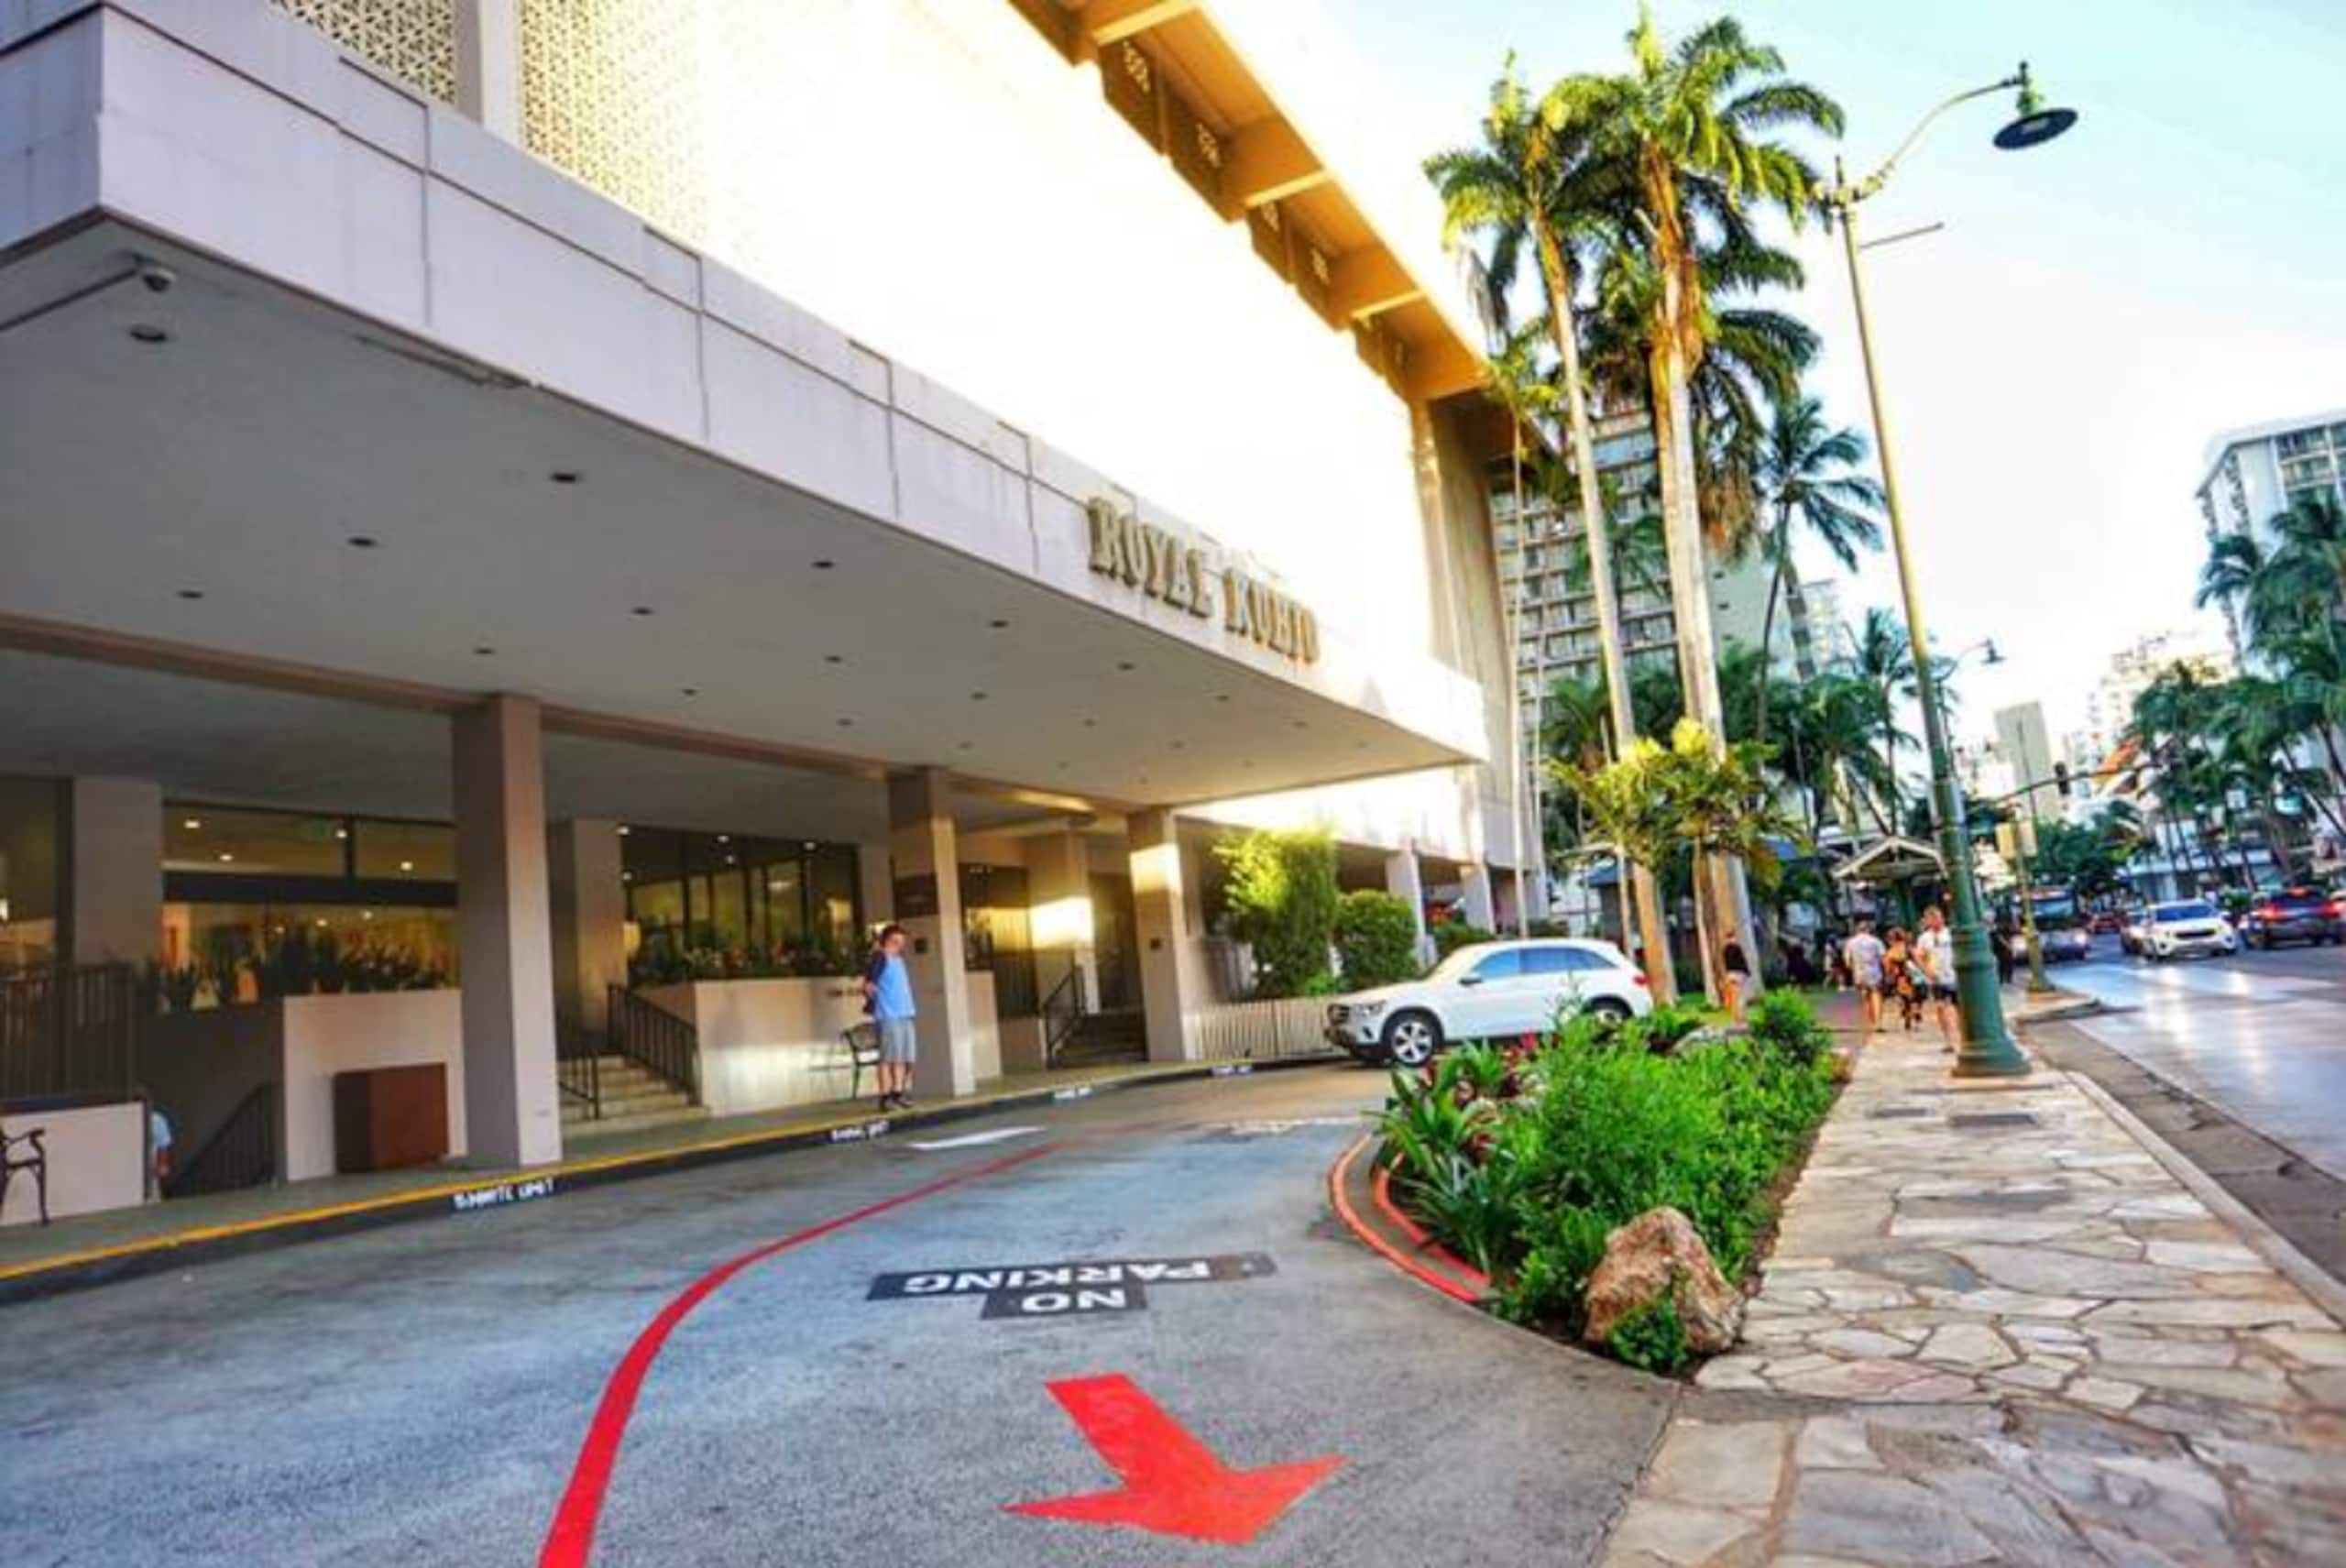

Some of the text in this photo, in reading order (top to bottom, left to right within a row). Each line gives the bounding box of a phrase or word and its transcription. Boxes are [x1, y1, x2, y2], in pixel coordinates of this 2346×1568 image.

[1087, 496, 1211, 619] ROYAL
[903, 1260, 1211, 1293] PARKING
[1021, 1288, 1127, 1313] NO
